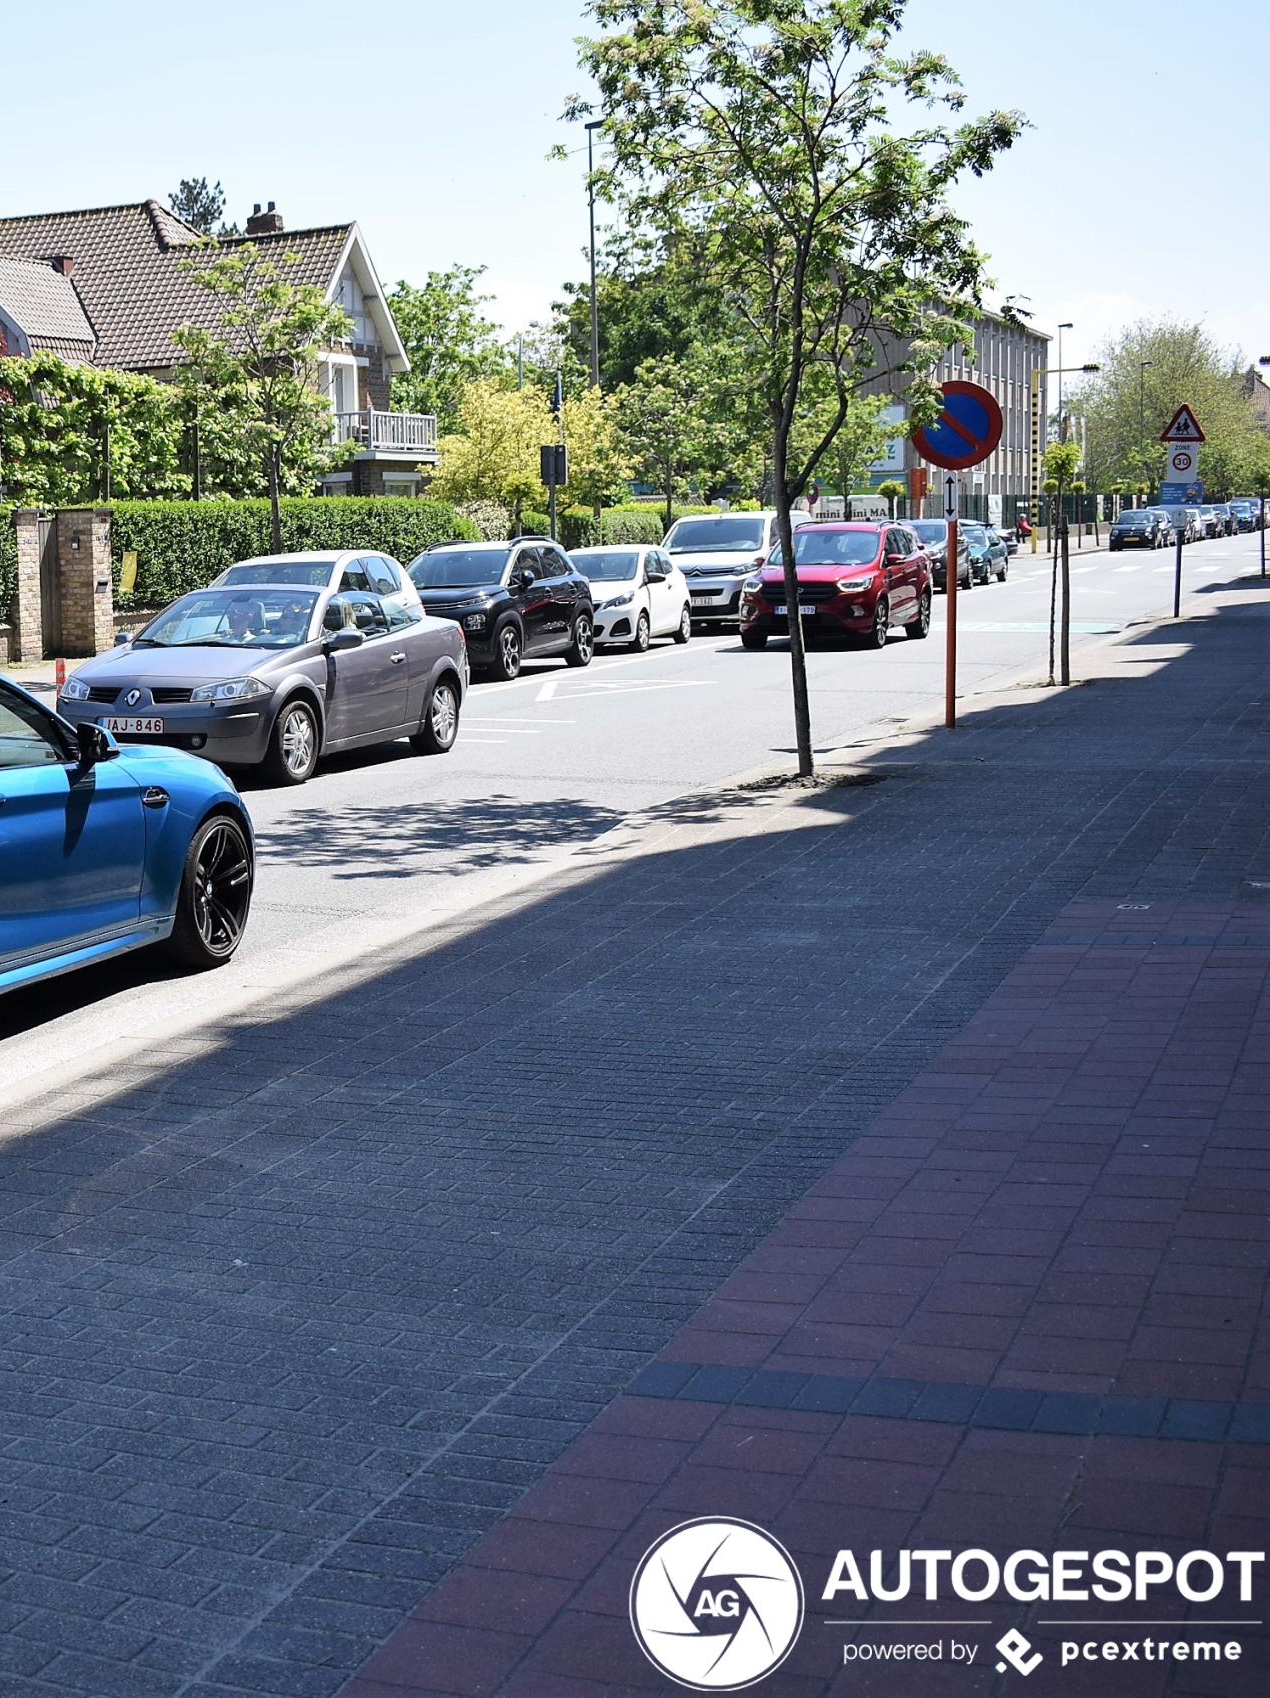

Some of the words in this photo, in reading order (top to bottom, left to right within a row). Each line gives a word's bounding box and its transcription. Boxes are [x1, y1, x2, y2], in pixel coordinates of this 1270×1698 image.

[1176, 458, 1188, 466] 30
[815, 509, 840, 519] mini
[844, 508, 867, 518] ini
